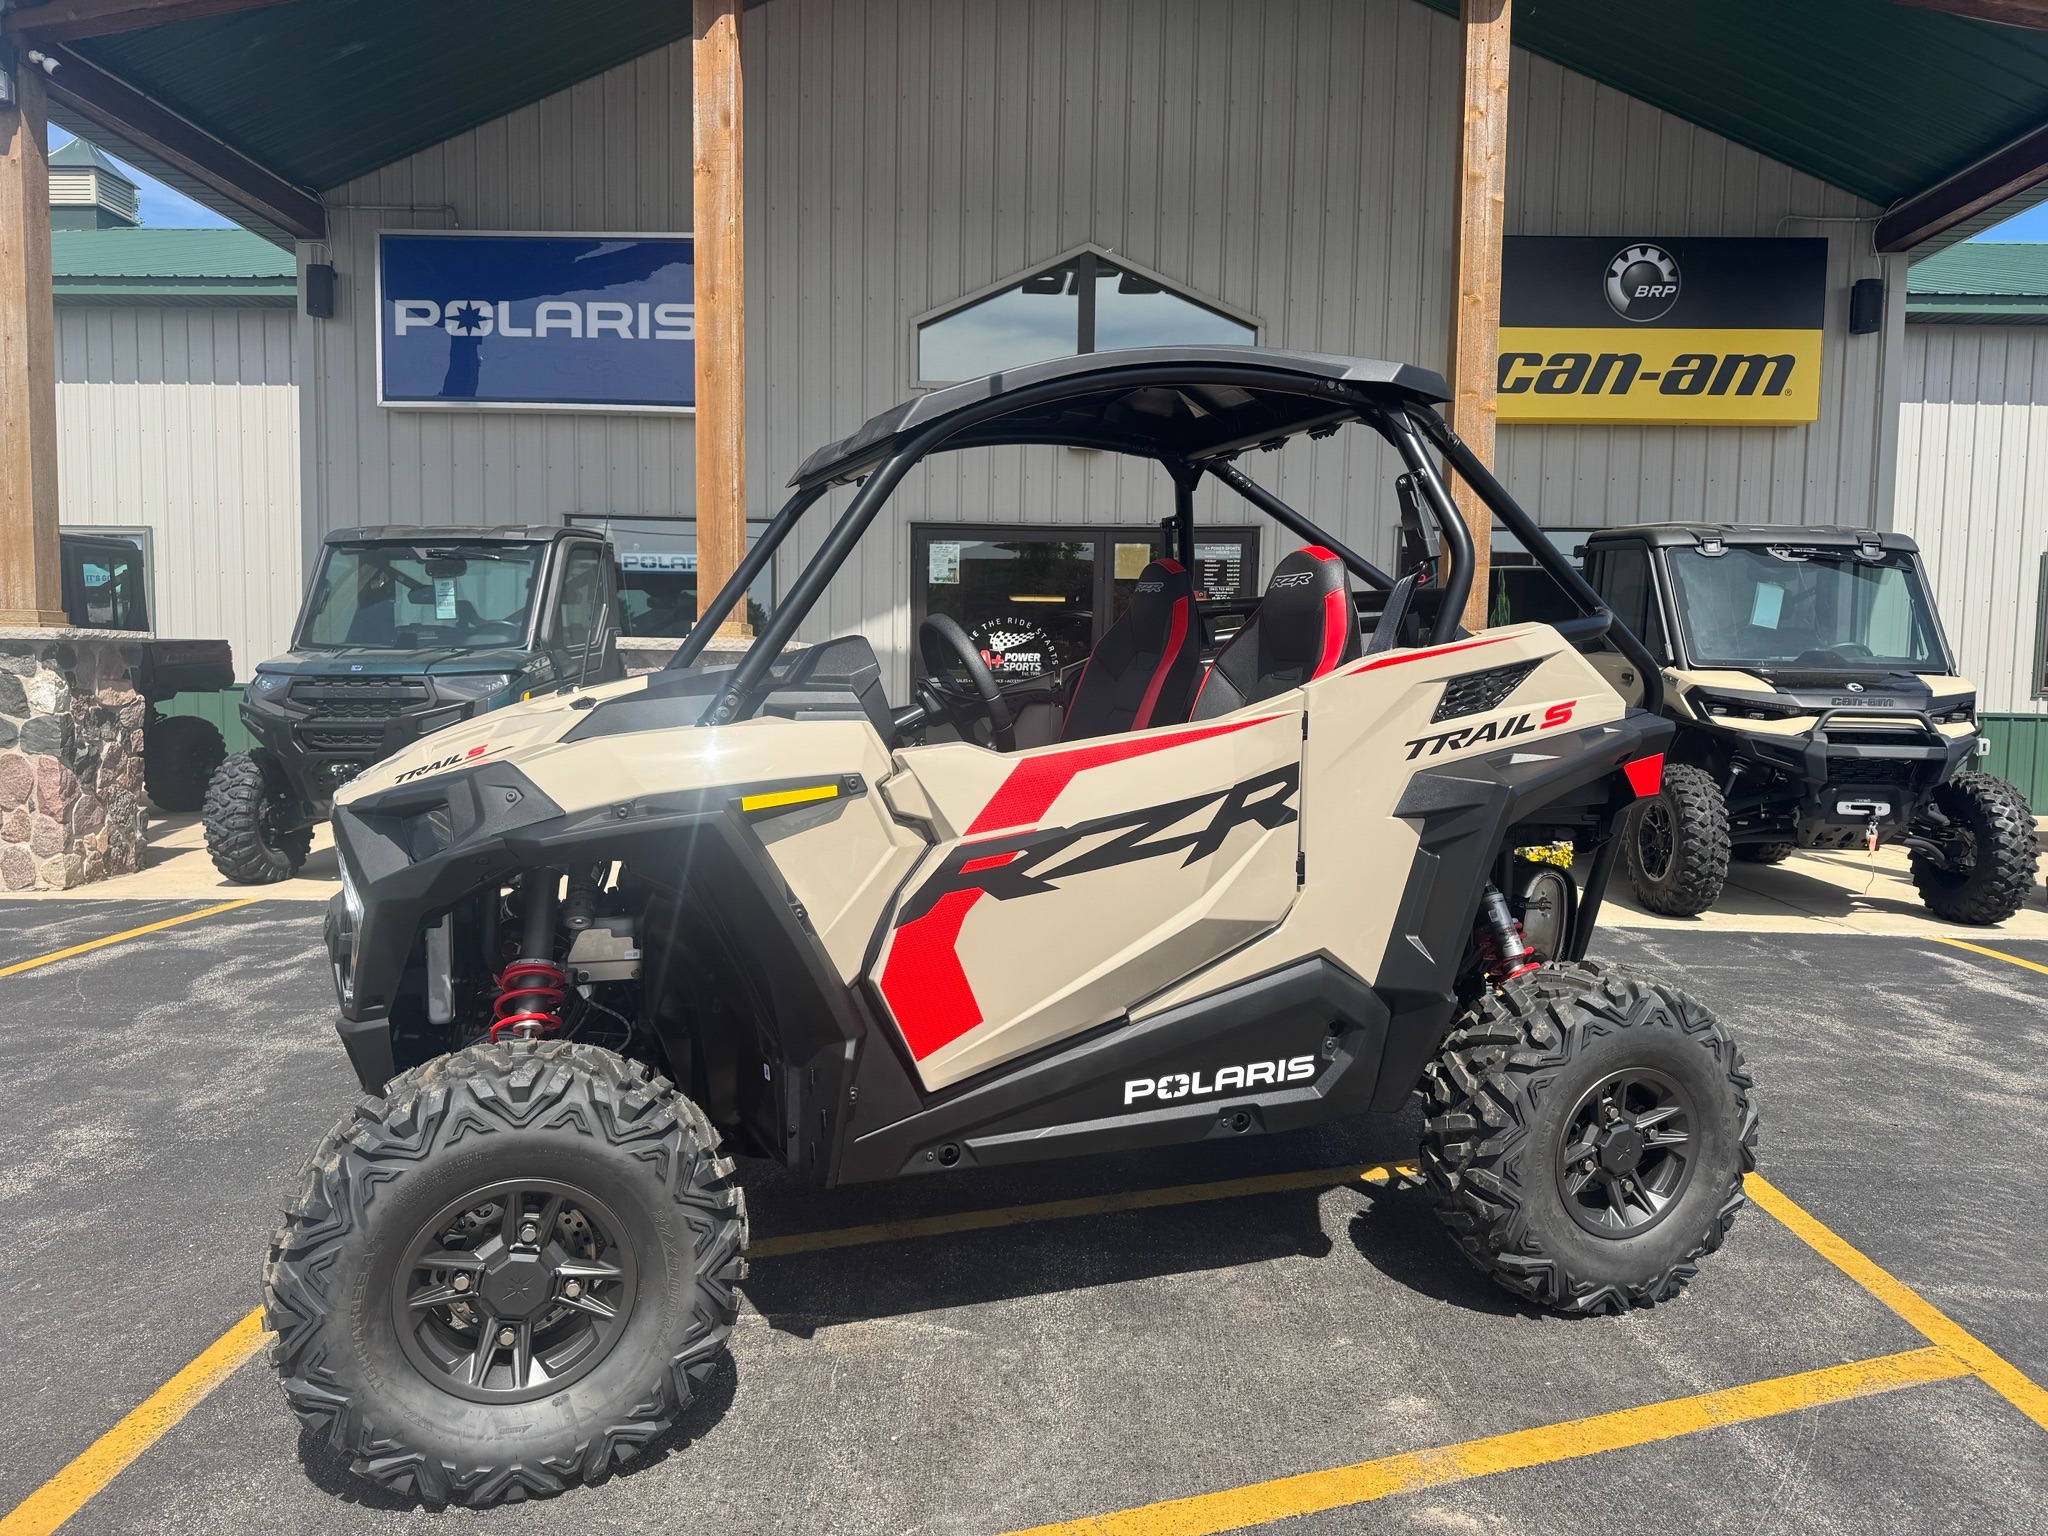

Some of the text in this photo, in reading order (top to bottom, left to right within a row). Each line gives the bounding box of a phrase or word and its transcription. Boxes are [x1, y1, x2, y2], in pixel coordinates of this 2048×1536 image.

[1634, 285, 1677, 298] BRP
[394, 299, 695, 340] POLARIS
[86, 574, 100, 582] IT'S
[1270, 571, 1314, 589] RZR
[1134, 581, 1165, 593] RZR
[981, 617, 1059, 665] THE RIDE STARTS
[526, 656, 550, 671] XP
[1004, 653, 1041, 662] POWER
[1003, 662, 1041, 671] SPORTS
[1831, 697, 1895, 707] can-am
[1404, 700, 1577, 761] TRAIL S
[395, 744, 488, 784] TRAIL S
[893, 761, 1300, 930] RZR
[1123, 1054, 1316, 1105] POLARIS
